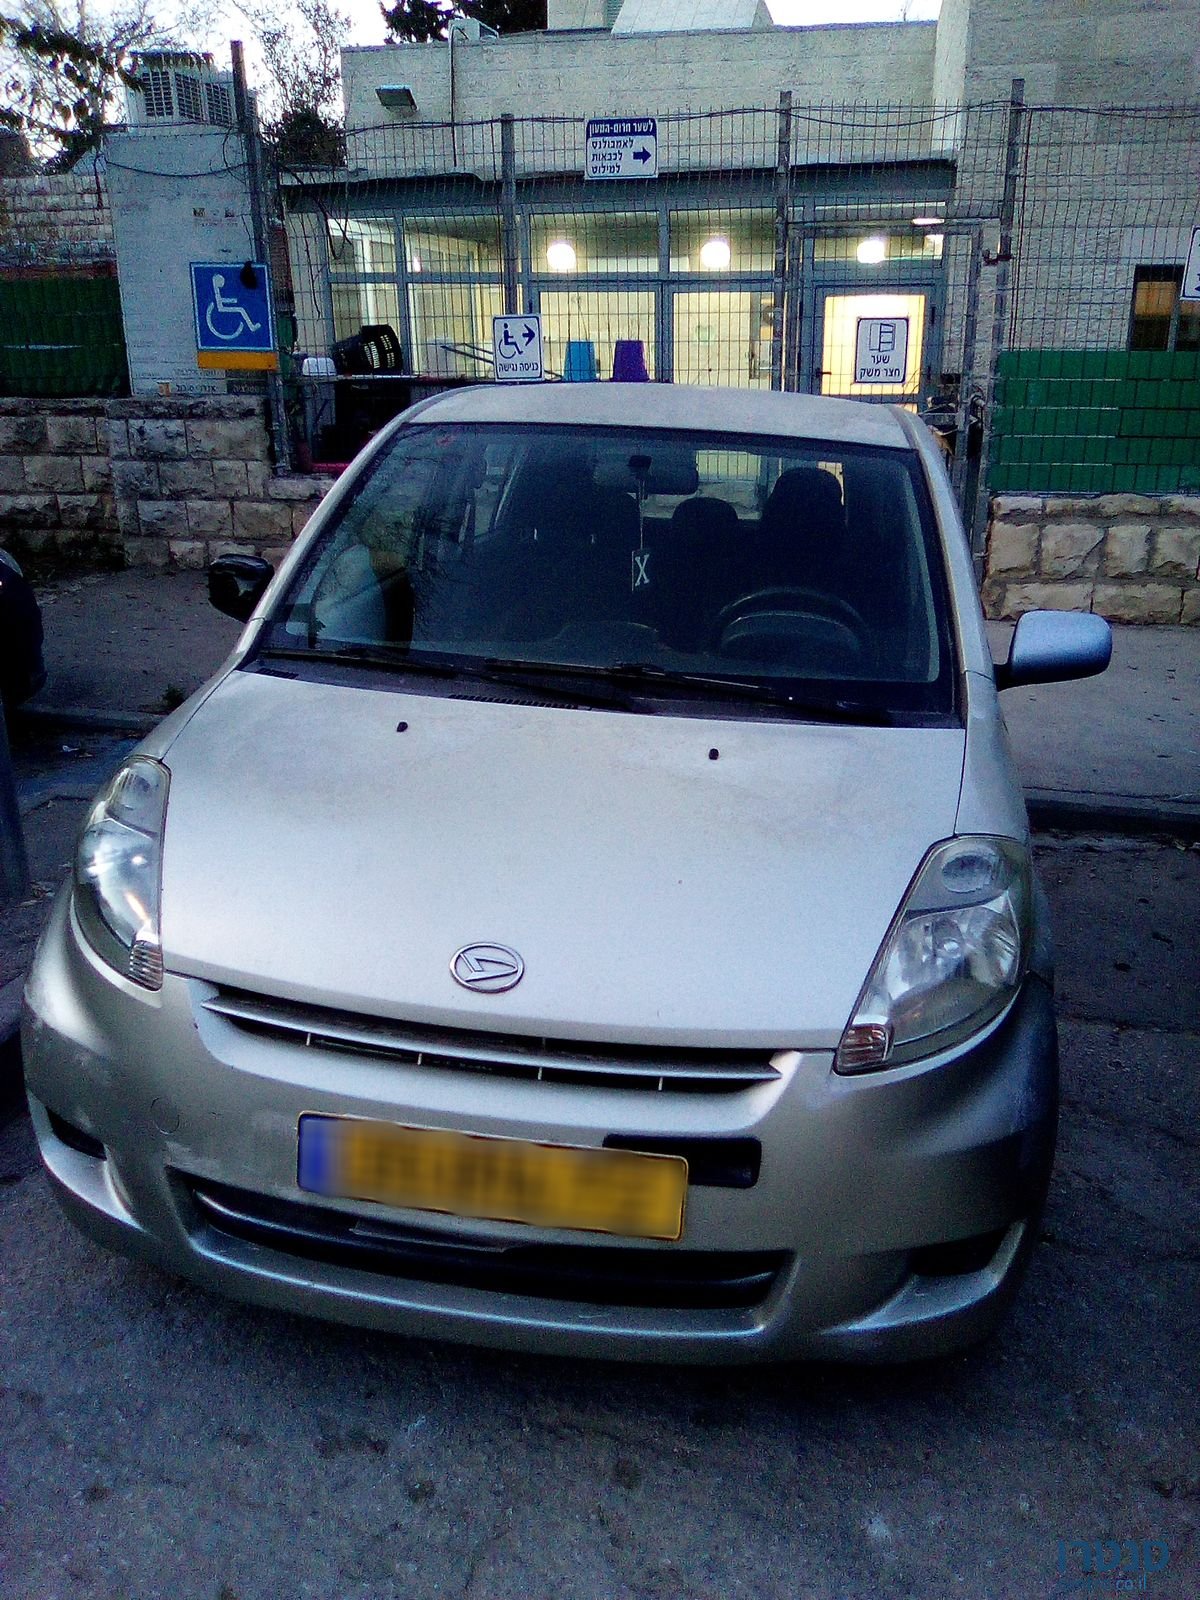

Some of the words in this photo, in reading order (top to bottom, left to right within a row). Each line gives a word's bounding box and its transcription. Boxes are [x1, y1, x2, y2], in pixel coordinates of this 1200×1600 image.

[633, 119, 654, 132] לשער
[591, 137, 634, 149] לאמבולנס
[591, 150, 623, 162] לכבאות
[871, 354, 890, 365] שער
[498, 362, 518, 373] נגישה
[519, 362, 539, 372] כניסה
[883, 368, 901, 377] חצר
[860, 368, 881, 380] משק
